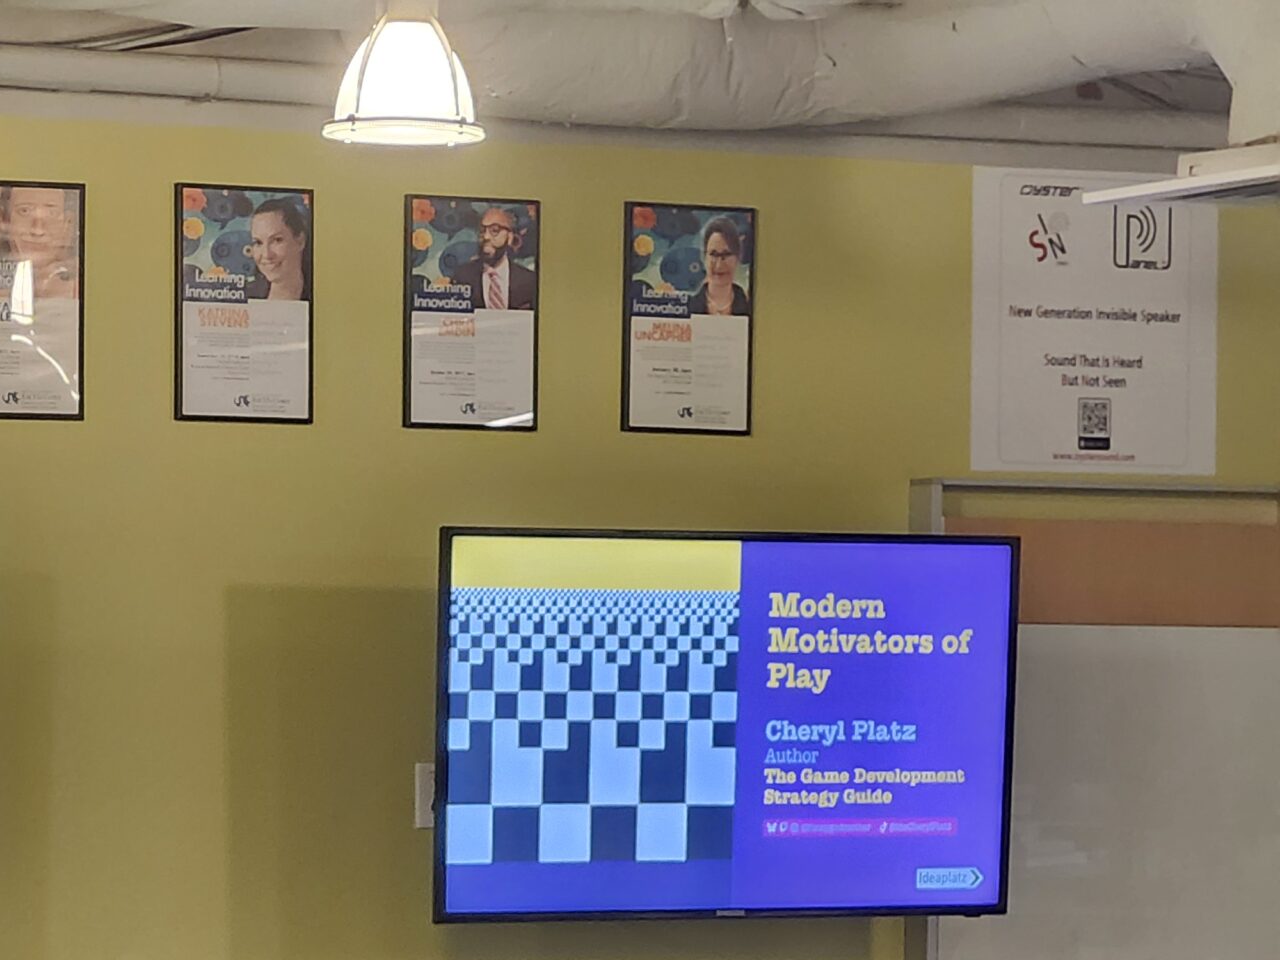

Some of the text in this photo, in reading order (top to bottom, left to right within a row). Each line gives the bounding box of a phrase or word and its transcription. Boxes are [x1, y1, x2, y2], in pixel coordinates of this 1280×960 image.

[195, 268, 245, 288] Learning
[185, 283, 245, 299] Innovation
[423, 279, 472, 298] Learning
[413, 293, 472, 309] Innovation
[633, 298, 688, 314] Innovation
[1009, 305, 1181, 324] New Generation Invisible Speaker
[1044, 353, 1076, 367] Sound
[1080, 354, 1100, 367] That
[1112, 356, 1143, 369] Heard
[1061, 374, 1127, 388] But Not Seen
[768, 592, 886, 619] Modern
[767, 627, 973, 654] Motivators of
[766, 662, 831, 694] Play
[765, 720, 917, 746] Cheryl Platz
[764, 748, 819, 764] Author
[763, 768, 966, 787] The Game Development
[763, 789, 893, 807] Strategy Guide
[919, 869, 968, 886] Ideaplatz
